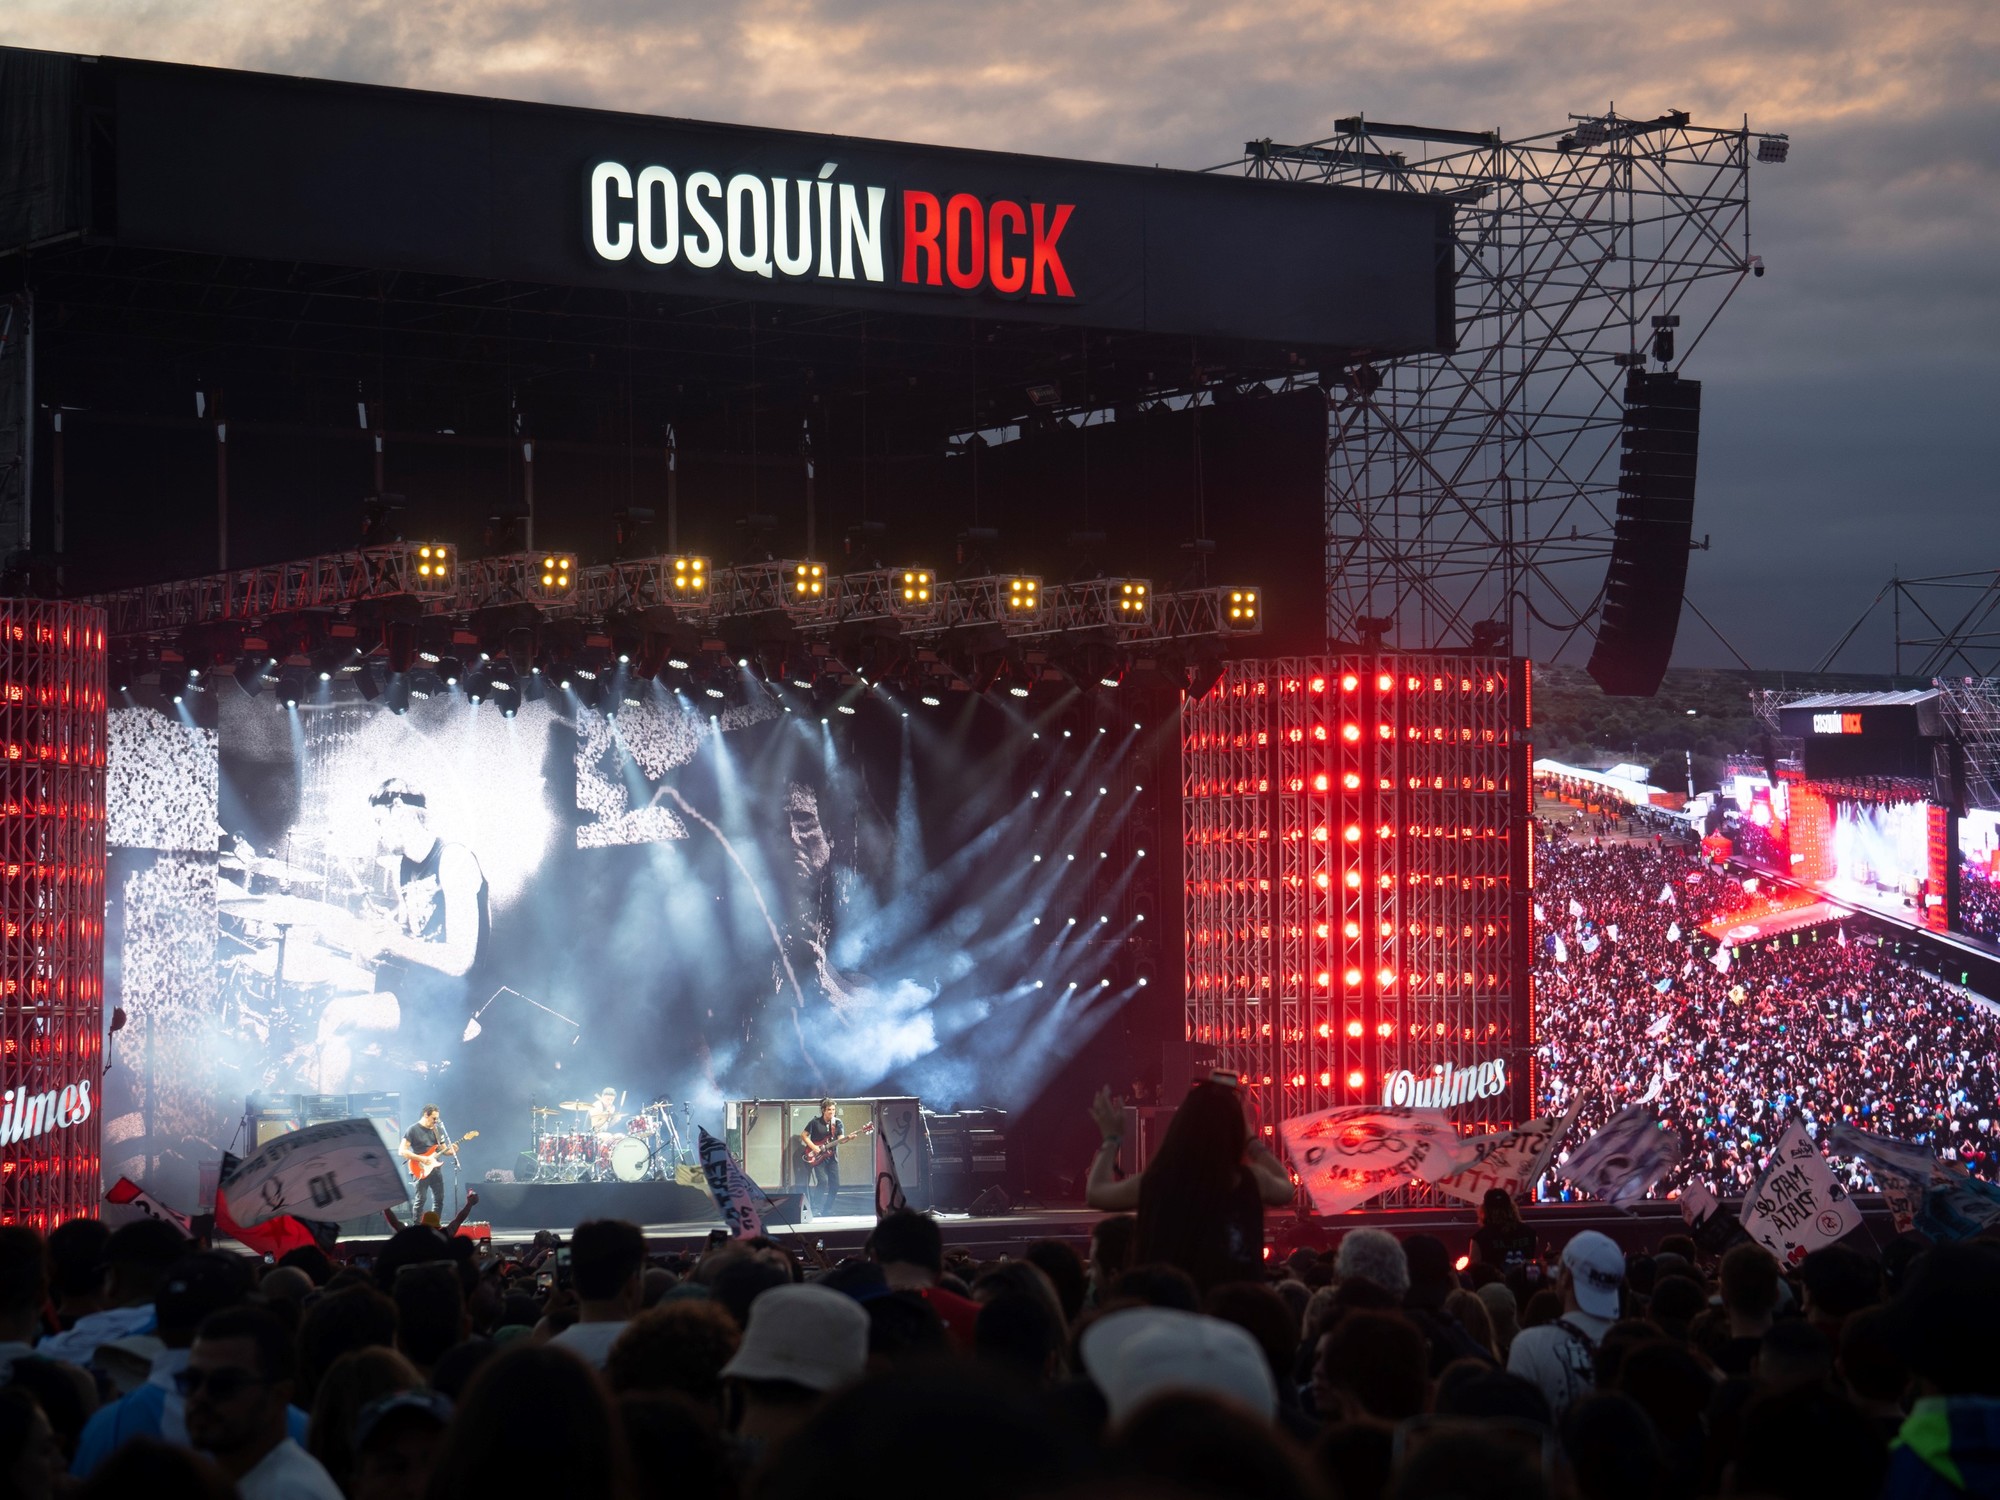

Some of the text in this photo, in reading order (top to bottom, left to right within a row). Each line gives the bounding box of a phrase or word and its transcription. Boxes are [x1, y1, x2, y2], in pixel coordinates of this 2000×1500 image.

[591, 161, 1076, 297] COSQUÍN ROCK
[0, 1079, 91, 1147] ilmes
[1383, 1058, 1506, 1109] Quilmes
